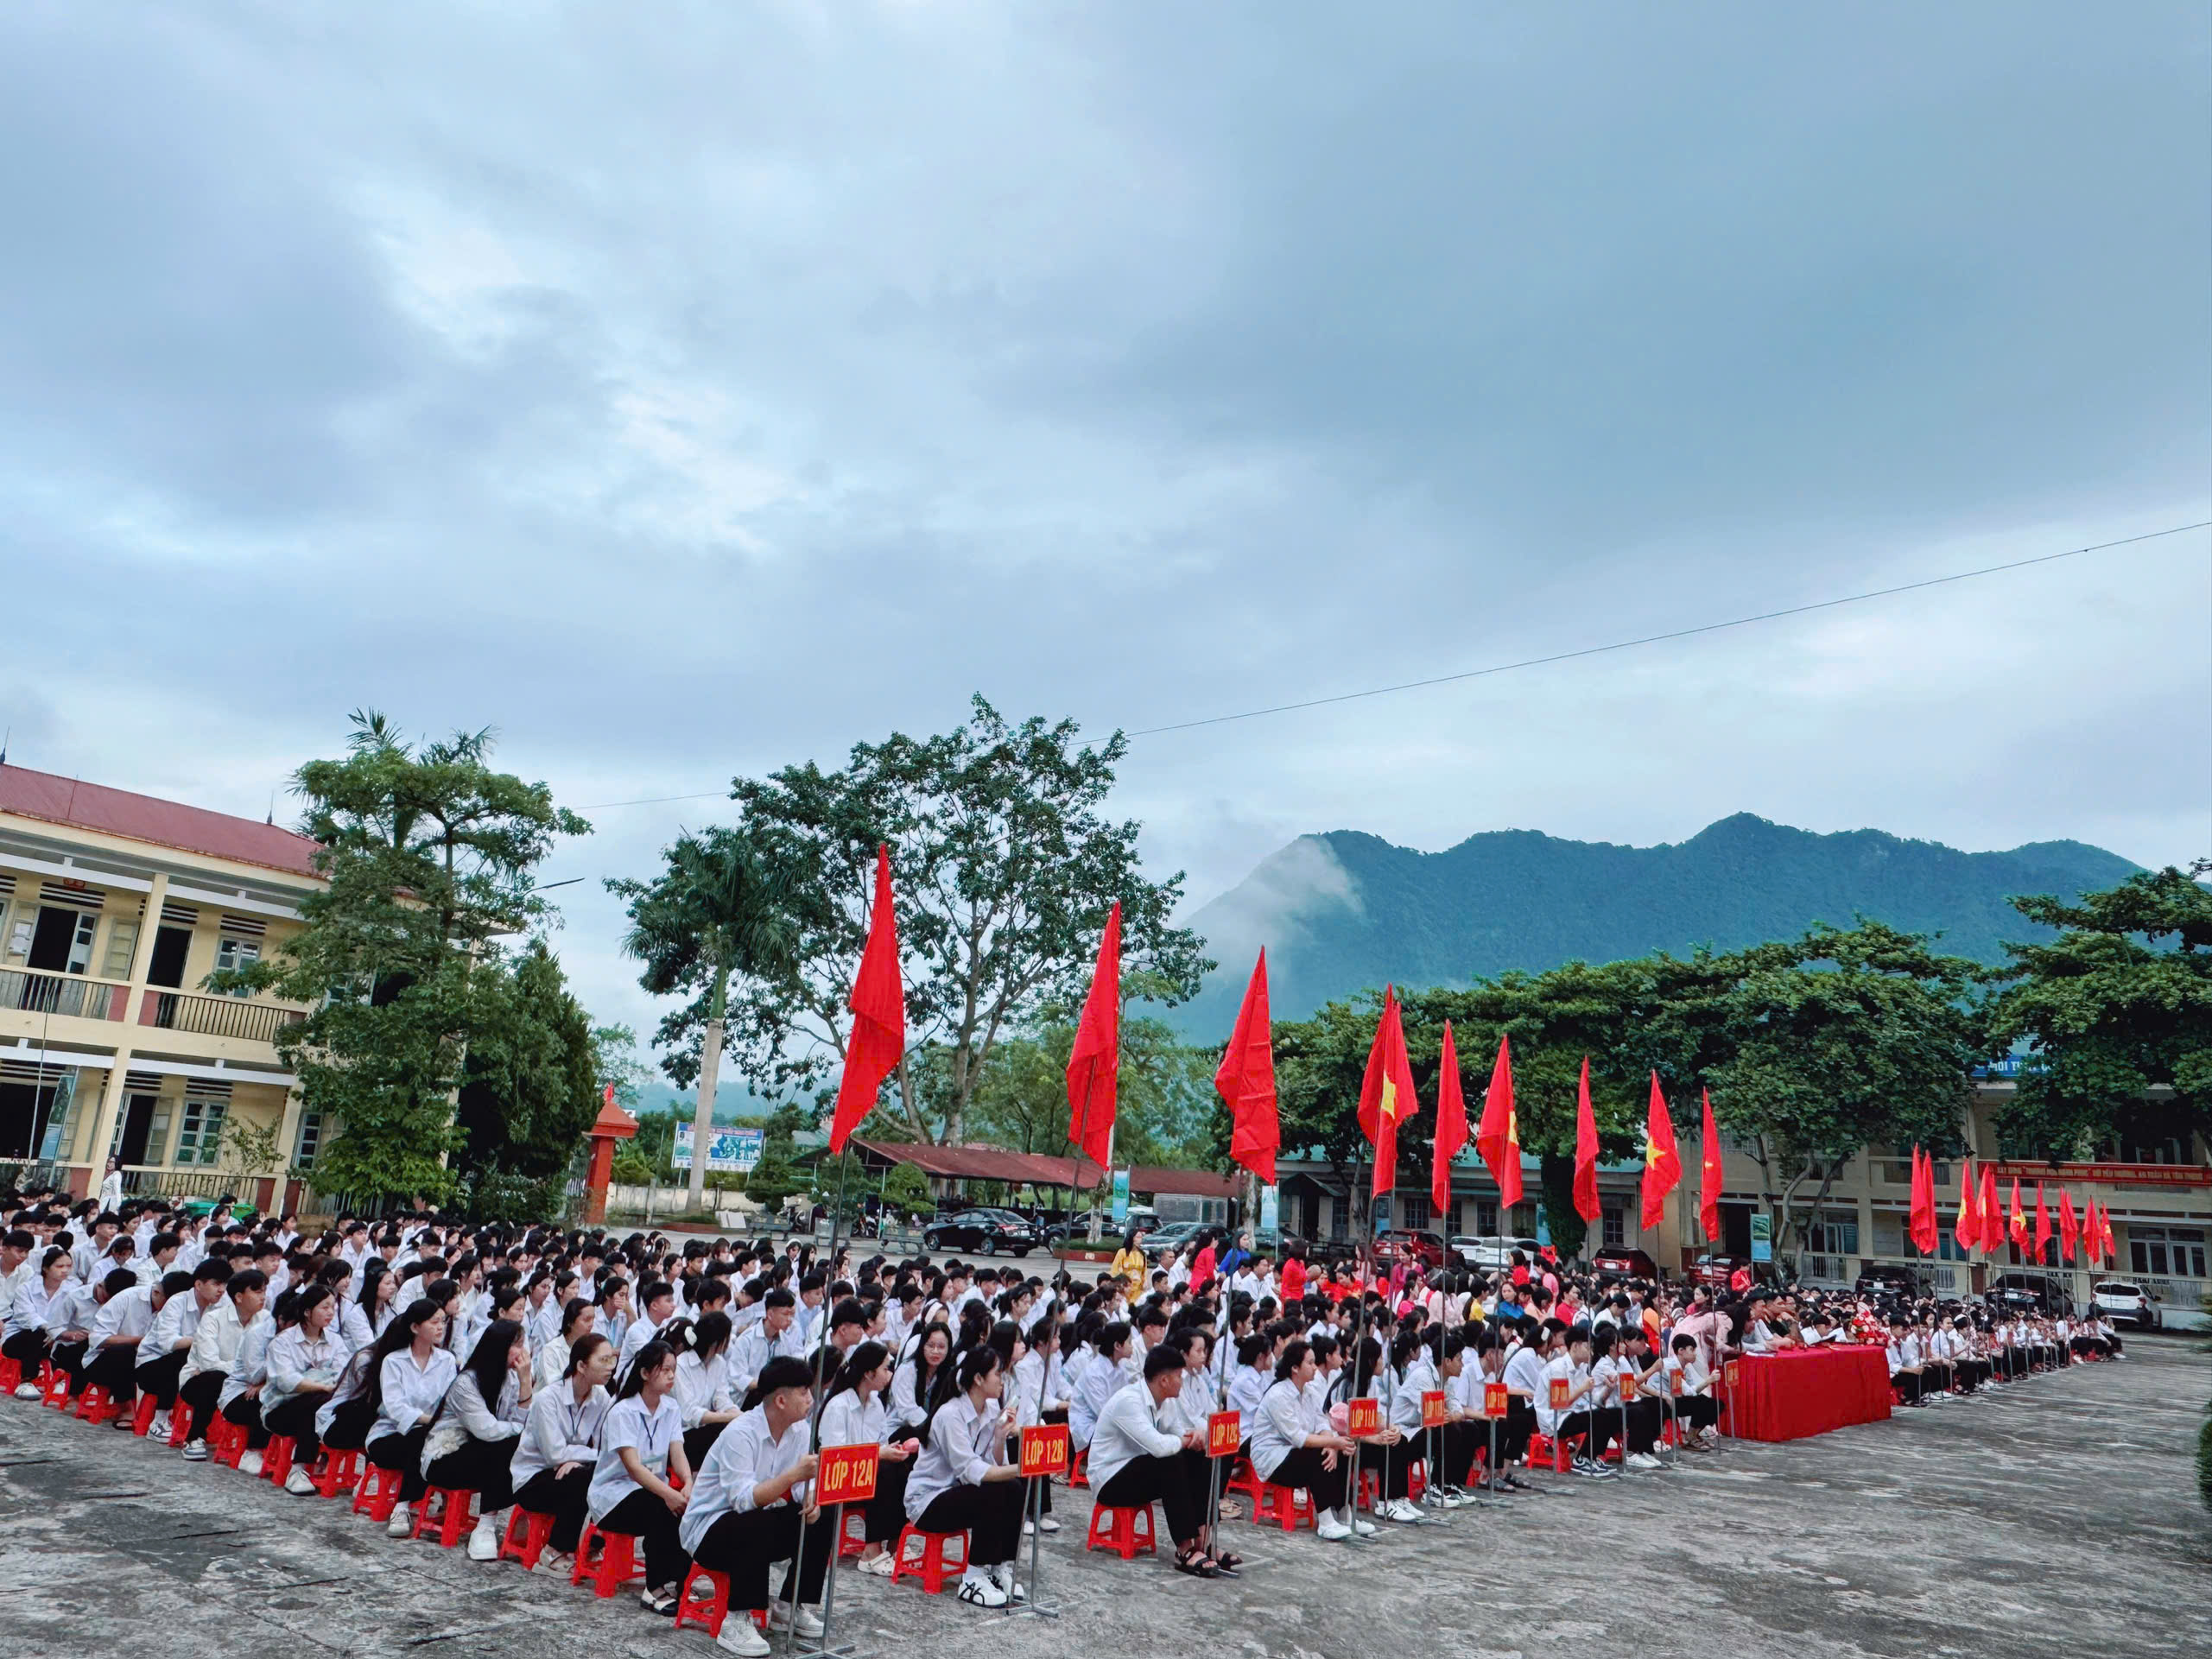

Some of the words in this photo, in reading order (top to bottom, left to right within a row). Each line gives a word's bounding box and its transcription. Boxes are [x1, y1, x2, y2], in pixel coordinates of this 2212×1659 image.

[1024, 1432, 1043, 1466] LỚP
[1046, 1438, 1064, 1466] 12B
[823, 1452, 848, 1491] LỚP
[852, 1458, 874, 1488] 12A
